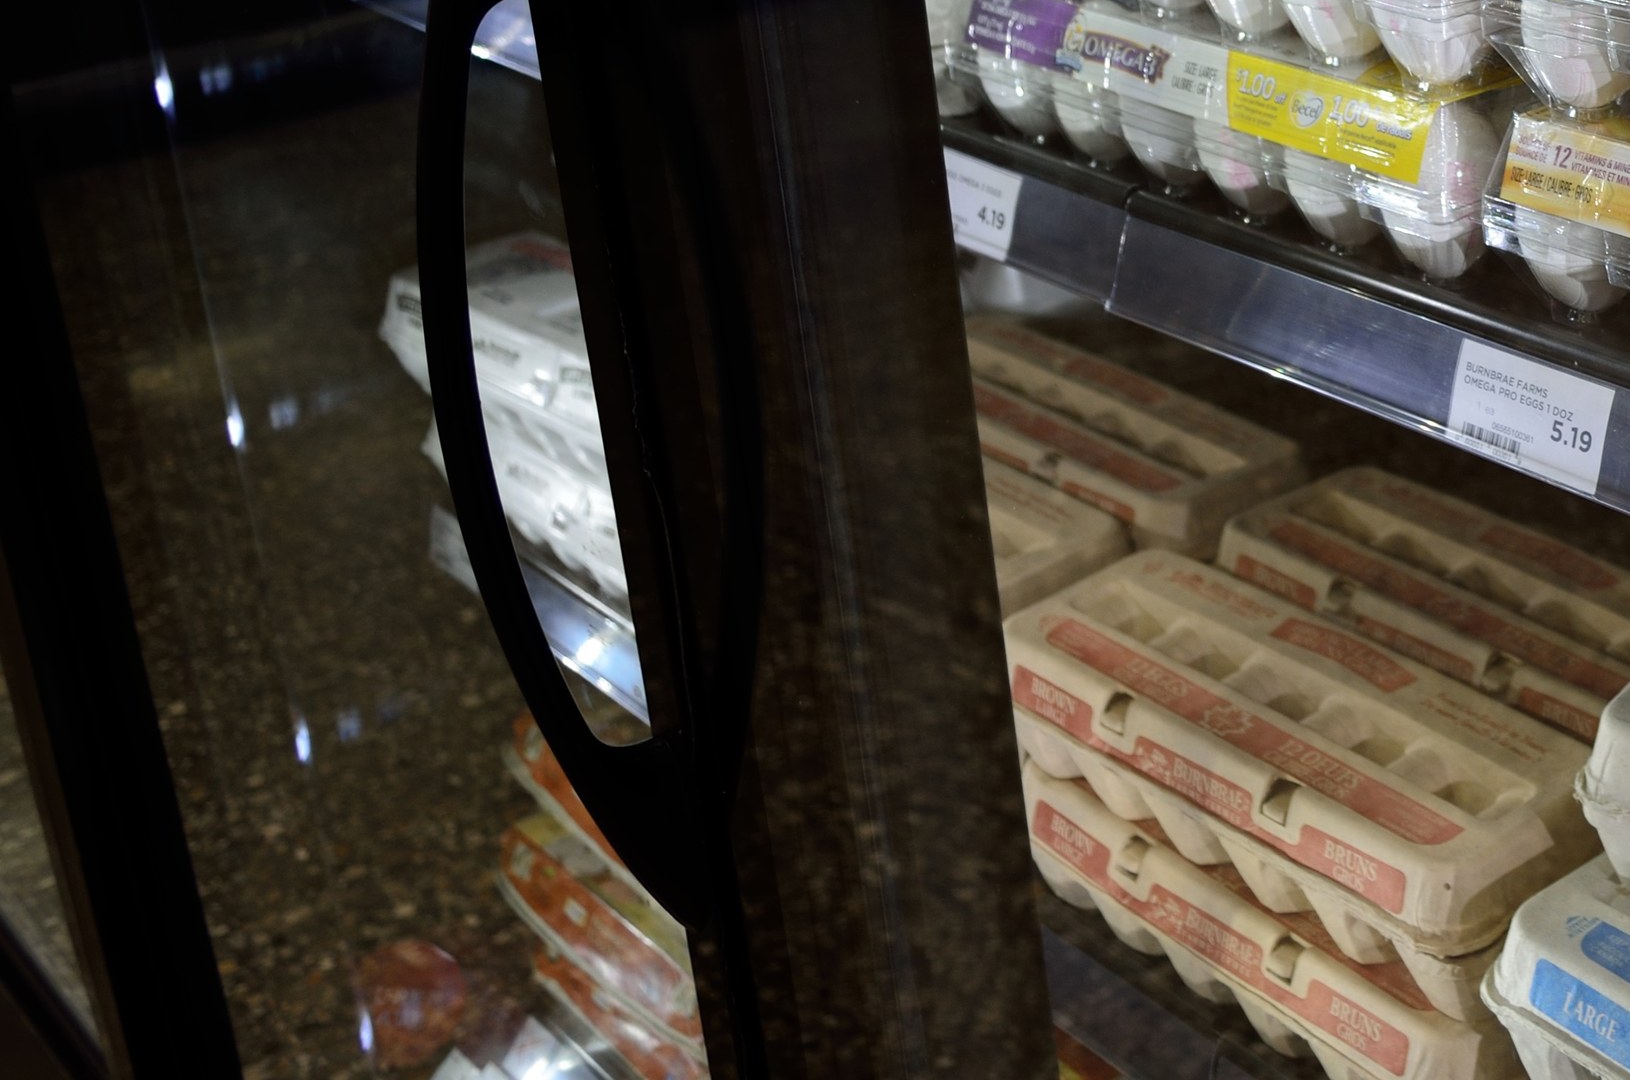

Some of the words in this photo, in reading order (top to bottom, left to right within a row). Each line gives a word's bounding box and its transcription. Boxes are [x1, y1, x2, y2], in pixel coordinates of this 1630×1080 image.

[1084, 36, 1145, 70] OMEGA
[1292, 99, 1320, 121] Becel
[1553, 145, 1572, 169] 12
[1571, 162, 1606, 180] VITAMINES
[1575, 151, 1606, 166] VITAMINS
[977, 204, 1007, 231] 4.19
[1466, 361, 1515, 387] BURNBRAE
[1516, 380, 1549, 399] FARMS
[1464, 375, 1496, 394] OMEGA
[1498, 385, 1517, 402] PRO
[1520, 394, 1544, 412] EGGS
[1553, 405, 1574, 422] DOZ
[1550, 420, 1593, 454] 5.19
[1031, 675, 1077, 715] BROWN
[1035, 697, 1067, 726] LARGE
[1172, 757, 1244, 806] BURNBRAE
[1050, 819, 1094, 857] BROWN
[1324, 840, 1378, 881] BRUNS
[1332, 866, 1365, 893] GROS
[1328, 994, 1384, 1042] BRUNS
[1563, 984, 1621, 1043] LARGE
[1335, 1021, 1368, 1051] GROS
